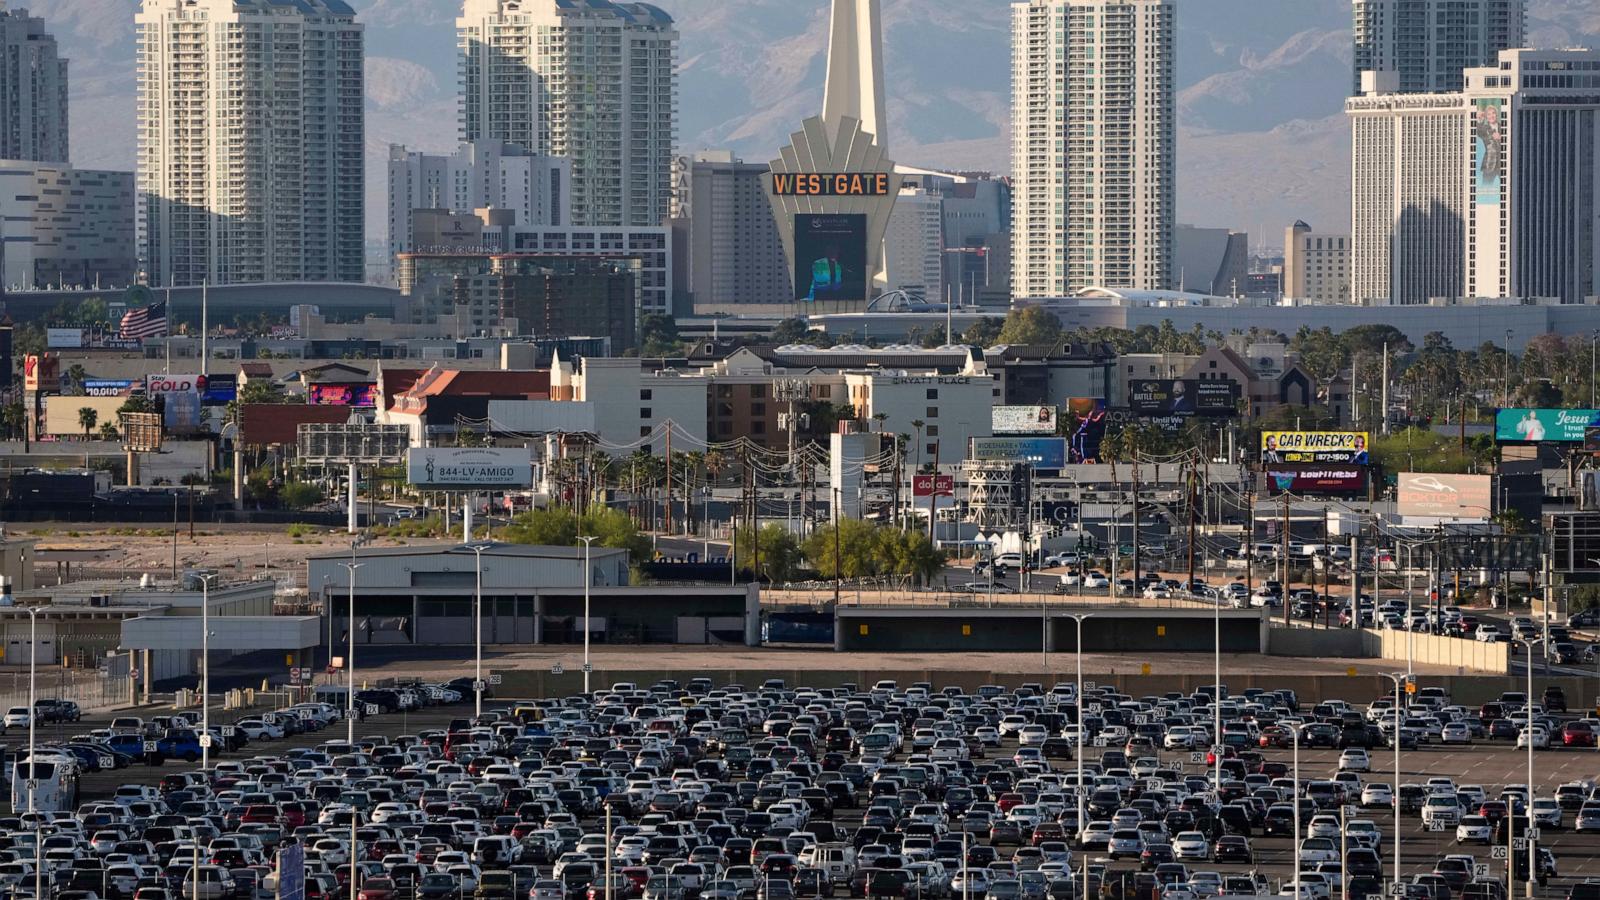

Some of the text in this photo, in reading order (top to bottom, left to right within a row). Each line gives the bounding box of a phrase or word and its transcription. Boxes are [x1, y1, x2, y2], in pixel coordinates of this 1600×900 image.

[774, 174, 887, 194] WESTGATE
[901, 377, 971, 385] HYATT PLACE
[150, 381, 191, 392] GOLD
[1134, 393, 1152, 401] BATTLE
[1152, 416, 1170, 424] Until
[1554, 410, 1590, 425] Jesus
[1280, 434, 1354, 447] CAR WRECK?
[440, 467, 514, 476] 844-LV-AMIGO
[918, 480, 948, 489] doar.
[367, 705, 376, 713] 2X
[1091, 703, 1099, 711] 2X
[264, 713, 273, 722] 2U
[302, 710, 310, 718] 2V
[1116, 727, 1126, 735] 2U
[1096, 737, 1104, 745] 2T
[145, 742, 155, 750] 2R
[1213, 746, 1222, 754] 2S
[1192, 753, 1202, 761] 2R
[101, 758, 112, 767] 2Q
[1171, 762, 1181, 770] 2Q
[60, 765, 69, 773] 2P
[27, 780, 37, 789] 2N
[1149, 781, 1159, 789] 2P
[1076, 786, 1086, 794] 2N
[1205, 795, 1216, 803] 2M
[1432, 820, 1442, 830] 2K
[1527, 829, 1538, 839] 2J
[1513, 839, 1524, 848] 2H
[1493, 847, 1506, 858] 2G
[1476, 864, 1487, 875] 2F
[1391, 883, 1404, 894] 2E
